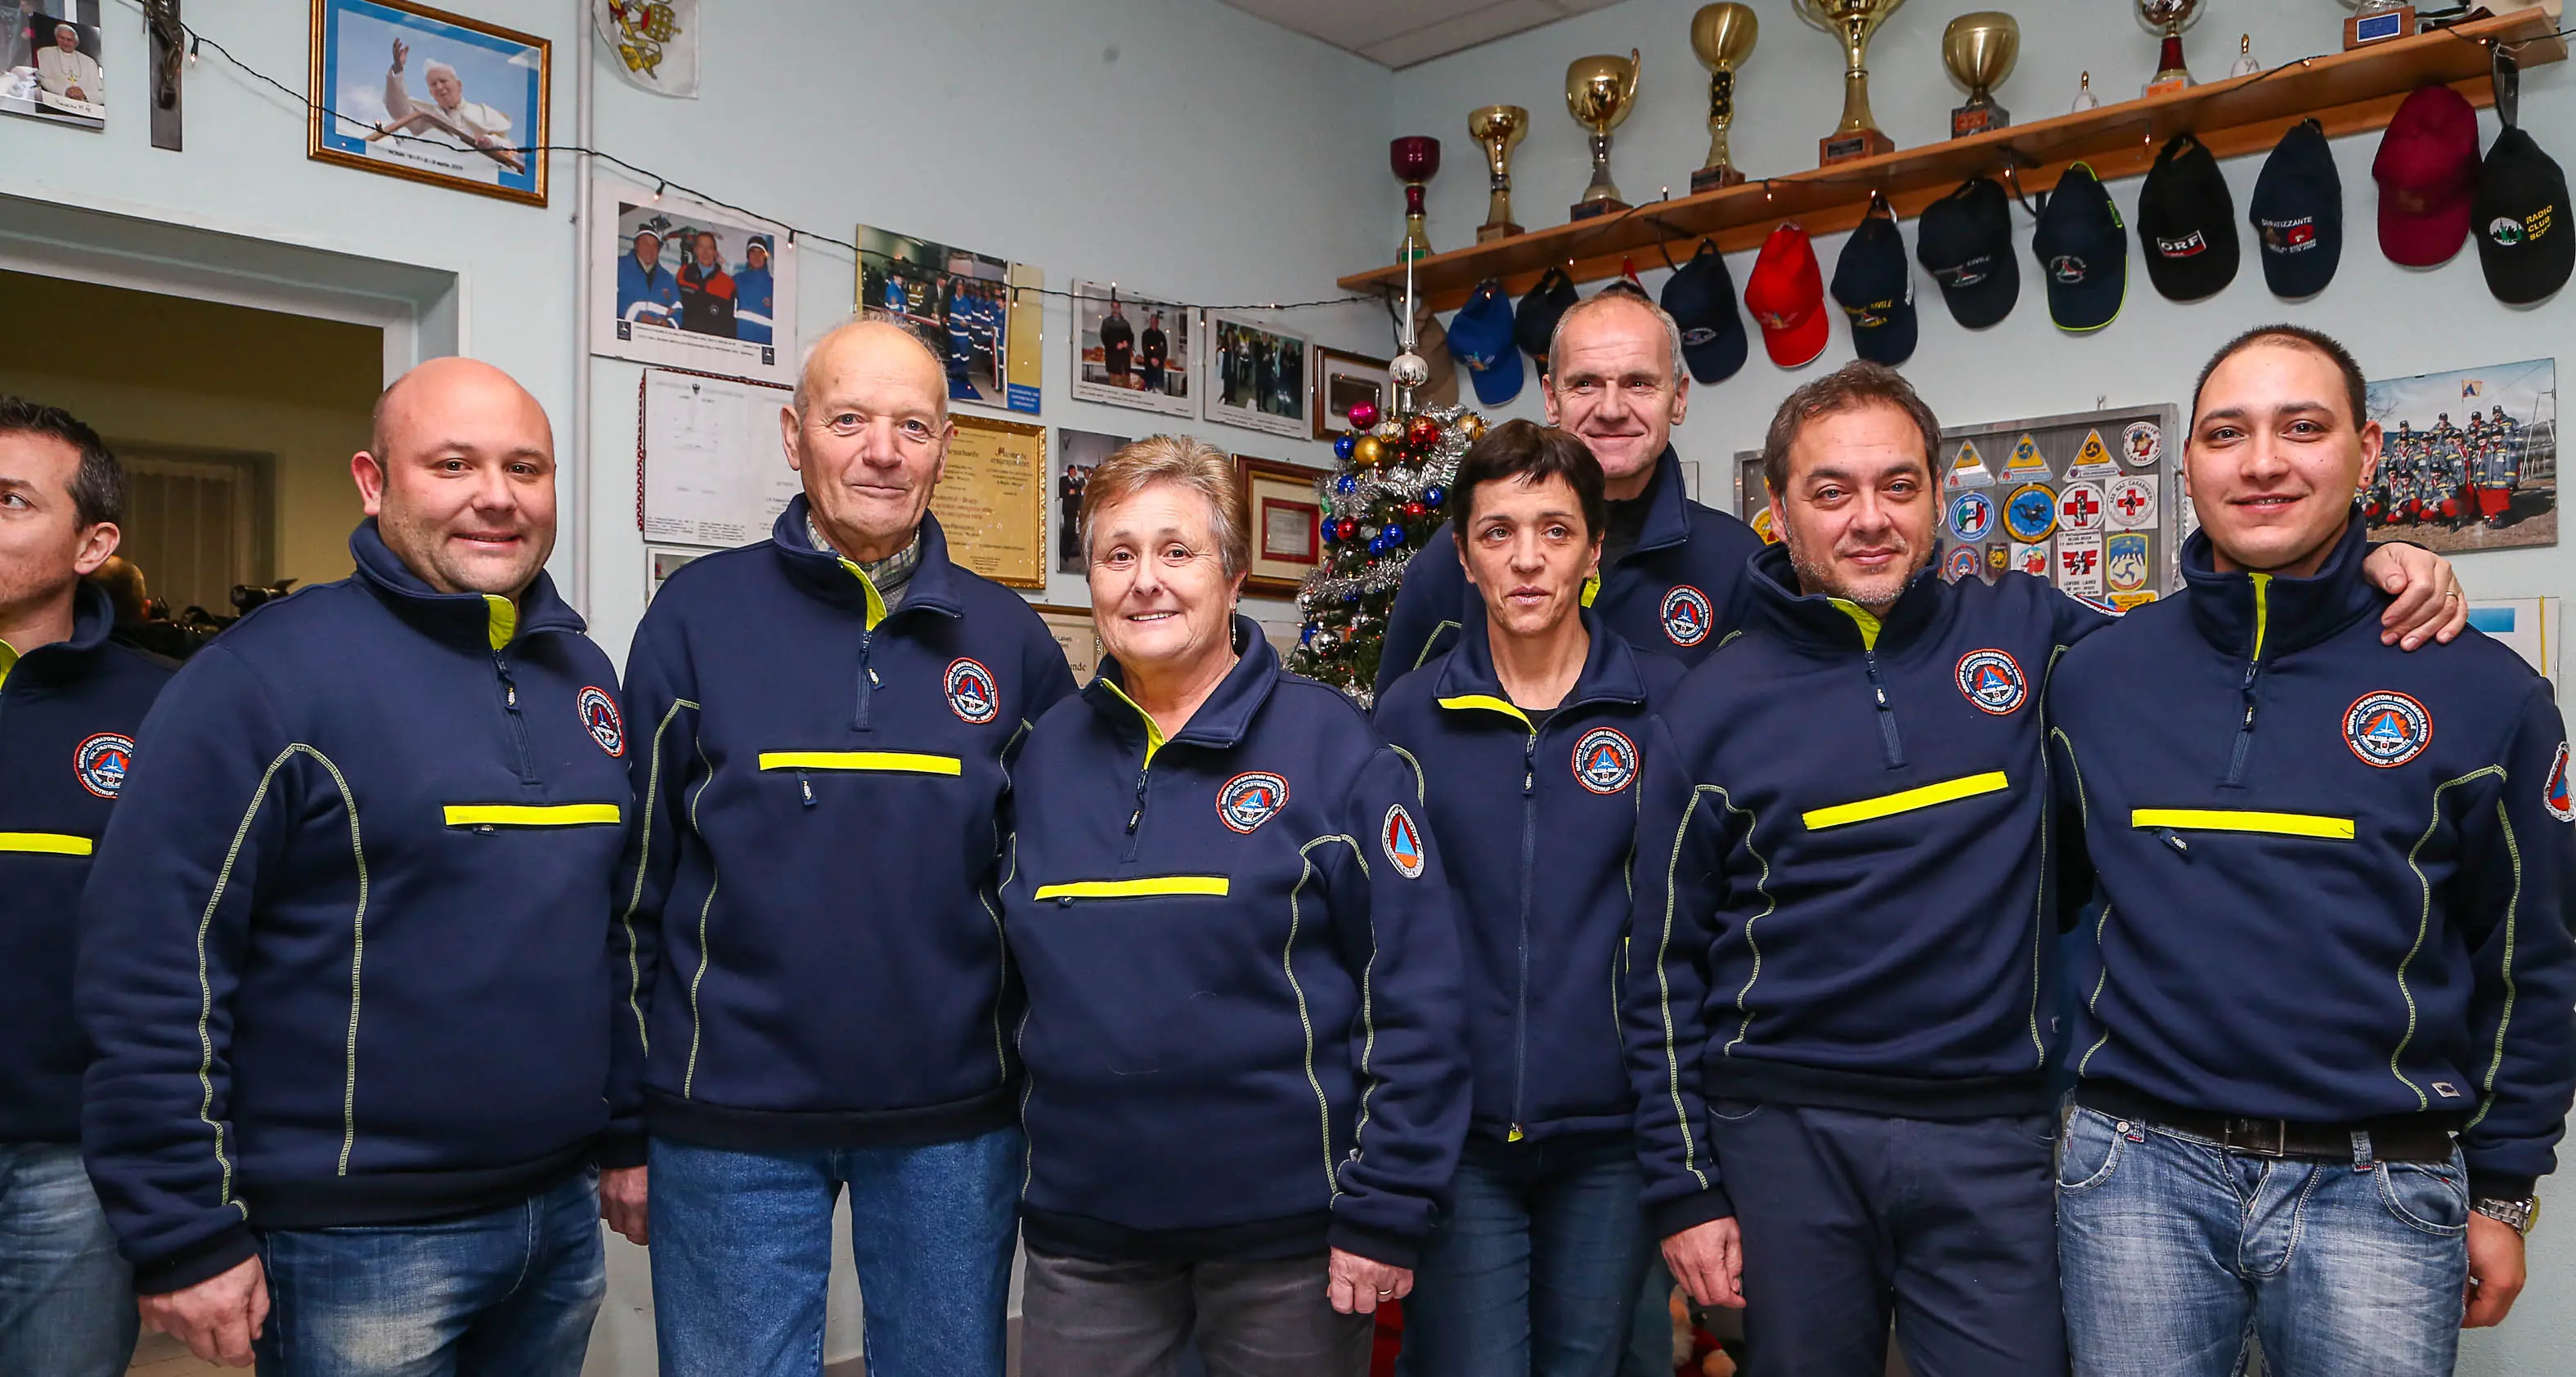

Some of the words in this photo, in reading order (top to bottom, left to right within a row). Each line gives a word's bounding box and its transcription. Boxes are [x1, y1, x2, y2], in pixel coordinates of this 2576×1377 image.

[2526, 204, 2552, 224] RADIO
[2528, 216, 2550, 231] CLUB
[2161, 235, 2198, 250] ORF
[2347, 710, 2359, 734] GRUPPO
[2357, 695, 2393, 711] OPERATORI
[2394, 697, 2426, 723] EMERGENZA
[2367, 704, 2407, 715] PROTEZIONE
[2405, 713, 2416, 729] CIVILE
[2351, 740, 2389, 765] FUNKNOTRUF
[2394, 745, 2419, 763] GRUPPE
